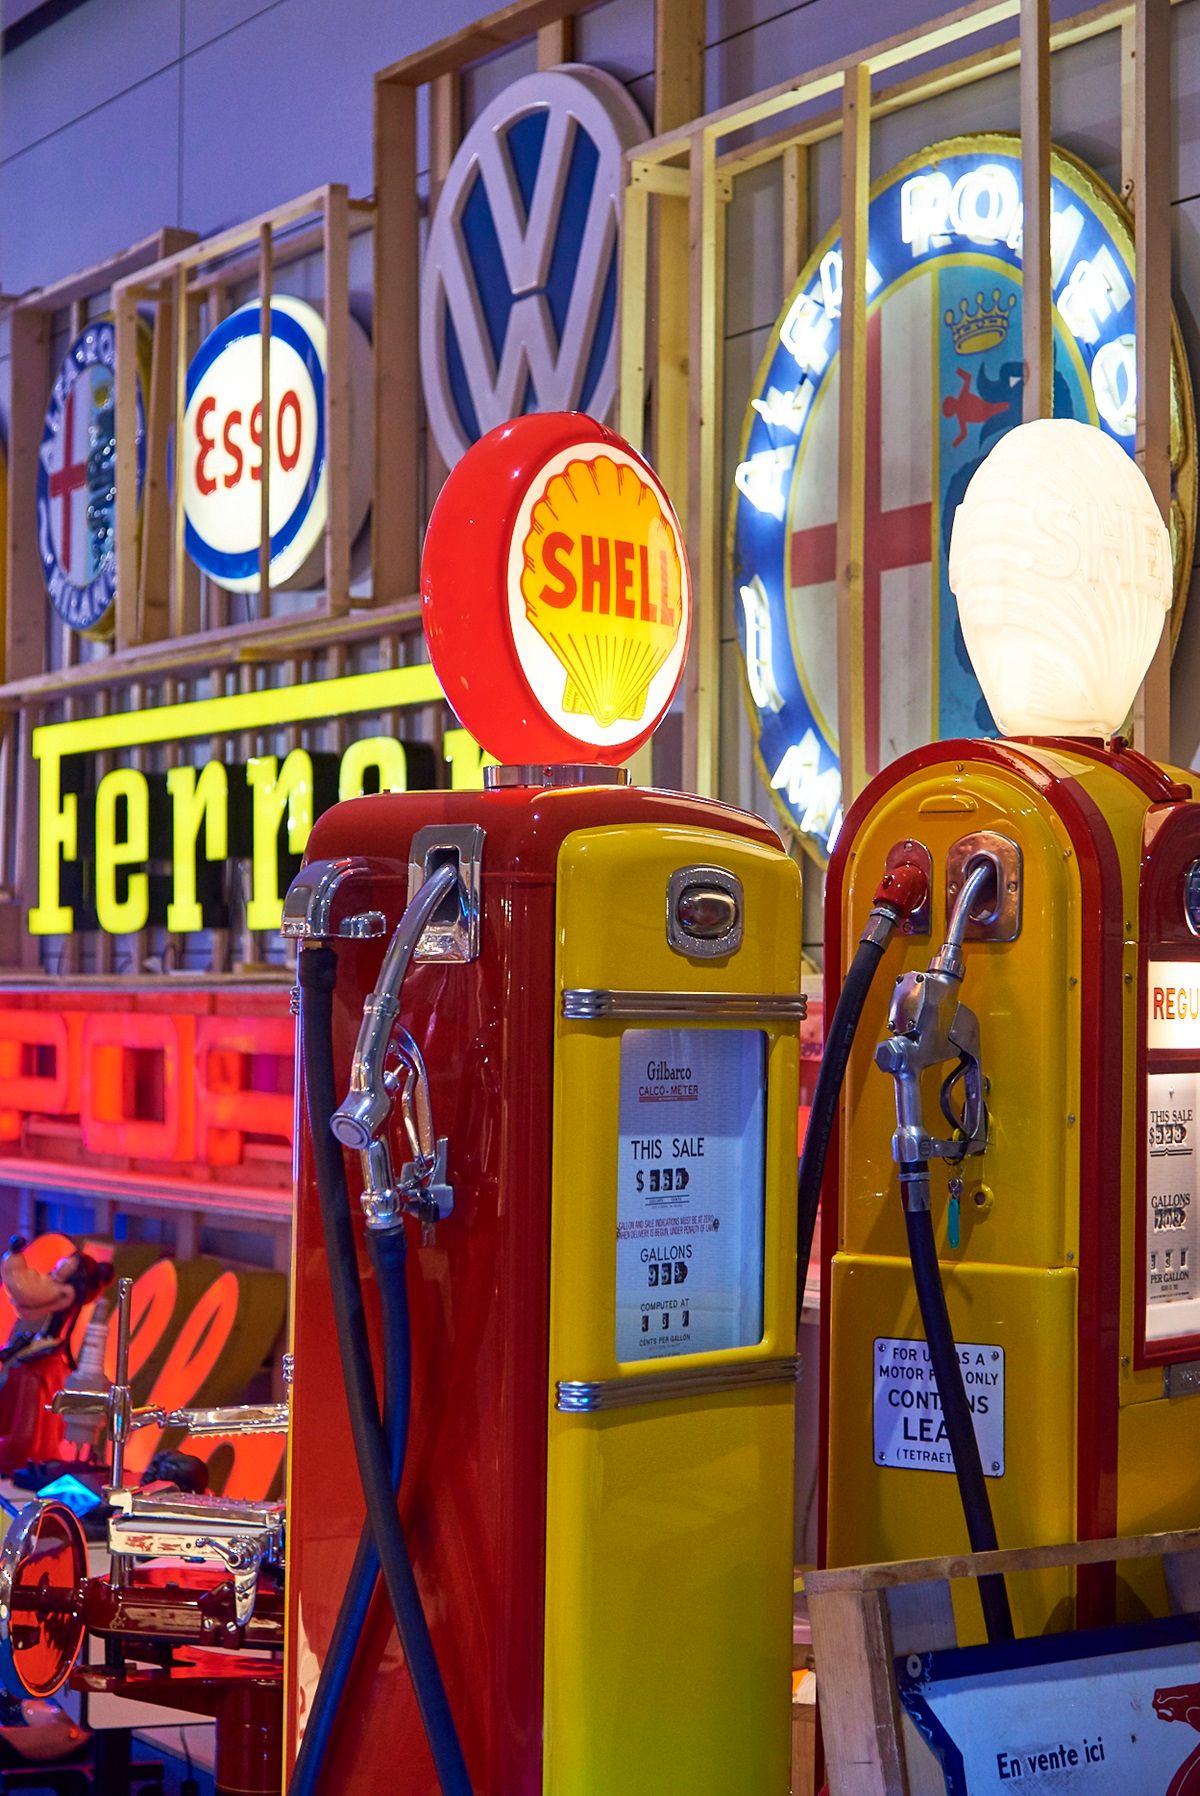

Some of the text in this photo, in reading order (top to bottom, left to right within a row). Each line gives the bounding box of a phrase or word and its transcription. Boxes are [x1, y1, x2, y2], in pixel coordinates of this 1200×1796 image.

[539, 531, 675, 628] SHELL
[646, 1060, 692, 1081] Gilbarco
[1150, 1109, 1193, 1123] THIS SALE
[631, 1137, 705, 1160] THIS SALE
[1151, 1193, 1191, 1209] GALLONS
[640, 1244, 692, 1263] GALLONS
[1150, 1271, 1190, 1284] PER GALLON
[640, 1298, 690, 1312] COMPUTED AT
[893, 1347, 917, 1361] FOR
[975, 1353, 985, 1366] A
[880, 1366, 924, 1380] MOTOR
[965, 1371, 999, 1386] ONLY
[888, 1389, 989, 1414] CONTNS
[903, 1416, 950, 1443] LEA
[997, 1736, 1105, 1779] En vente ici
